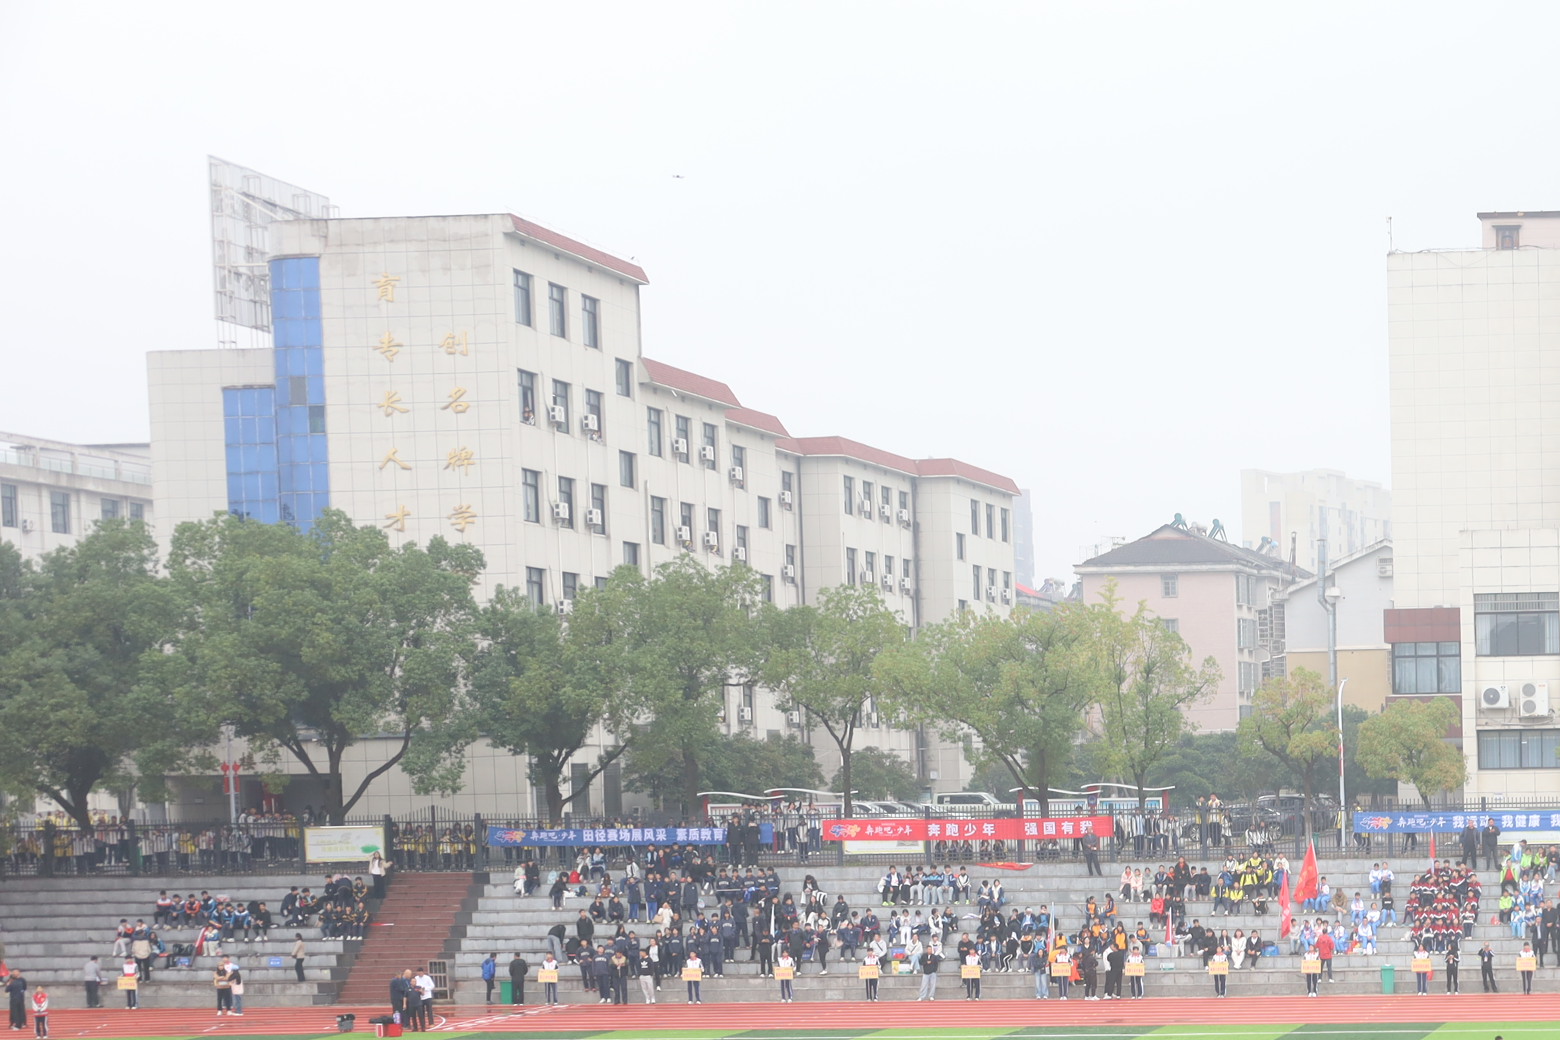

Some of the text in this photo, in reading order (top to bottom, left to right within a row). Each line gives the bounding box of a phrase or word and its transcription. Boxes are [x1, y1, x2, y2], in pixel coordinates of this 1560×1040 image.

[371, 272, 412, 533] 育专长人才
[438, 330, 482, 585] 创名牌学
[928, 820, 1093, 837] 奔跑少年 强国有我
[1501, 814, 1541, 828] 我健康
[583, 828, 728, 842] 田径赛场展风采 素质教育
